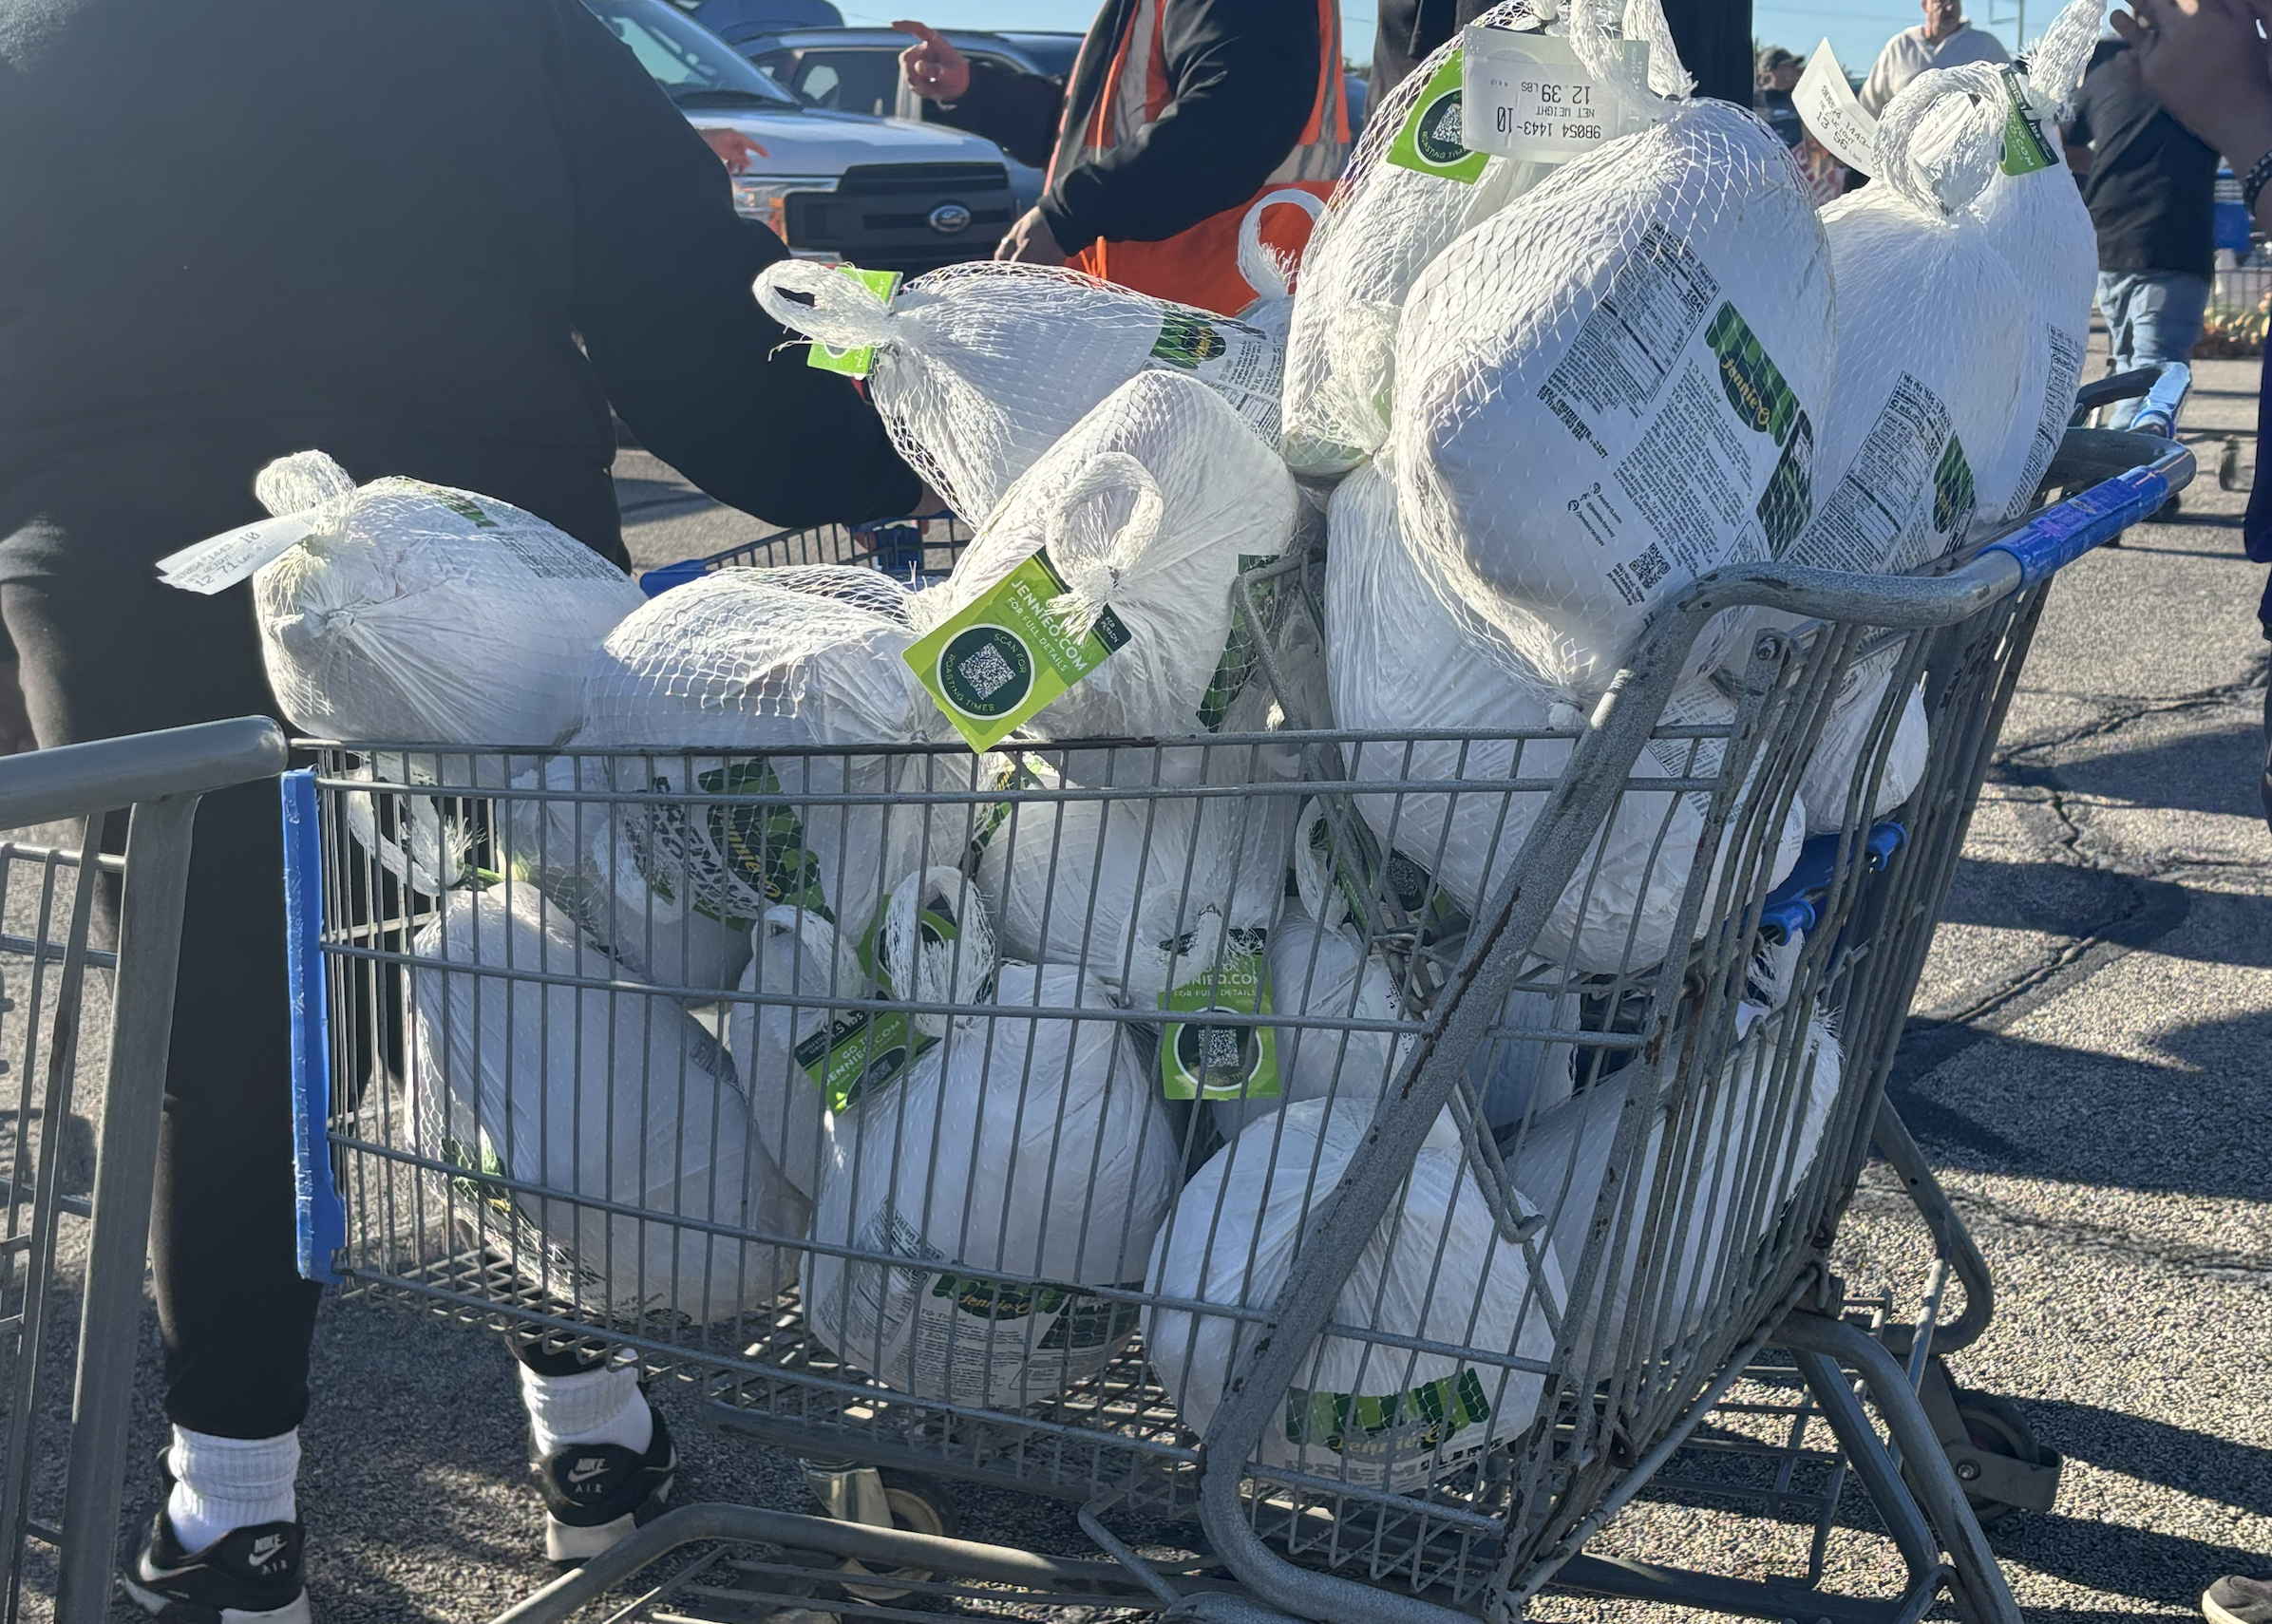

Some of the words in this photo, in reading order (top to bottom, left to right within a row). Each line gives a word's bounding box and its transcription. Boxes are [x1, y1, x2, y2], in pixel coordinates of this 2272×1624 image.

[1520, 81, 1538, 92] LBS
[1535, 104, 1571, 117] WEIGHT
[1577, 106, 1595, 118] NET
[1561, 123, 1601, 139] 9B054
[1447, 148, 1466, 159] TIM
[1570, 426, 1585, 443] USE
[1010, 578, 1089, 672] JENNIEO.COM
[1007, 596, 1023, 615] FOR
[1021, 614, 1041, 637] FULL
[1039, 635, 1070, 672] DETAILS
[994, 633, 1019, 656] SCAN
[1017, 651, 1028, 674] FOR
[948, 653, 965, 703] ROASTING
[965, 698, 995, 711] TIMES
[840, 1043, 859, 1060] GO
[576, 1458, 606, 1471] NIKE
[575, 1482, 603, 1493] AIR
[255, 1533, 283, 1553] NIKE
[261, 1559, 288, 1576] AIR
